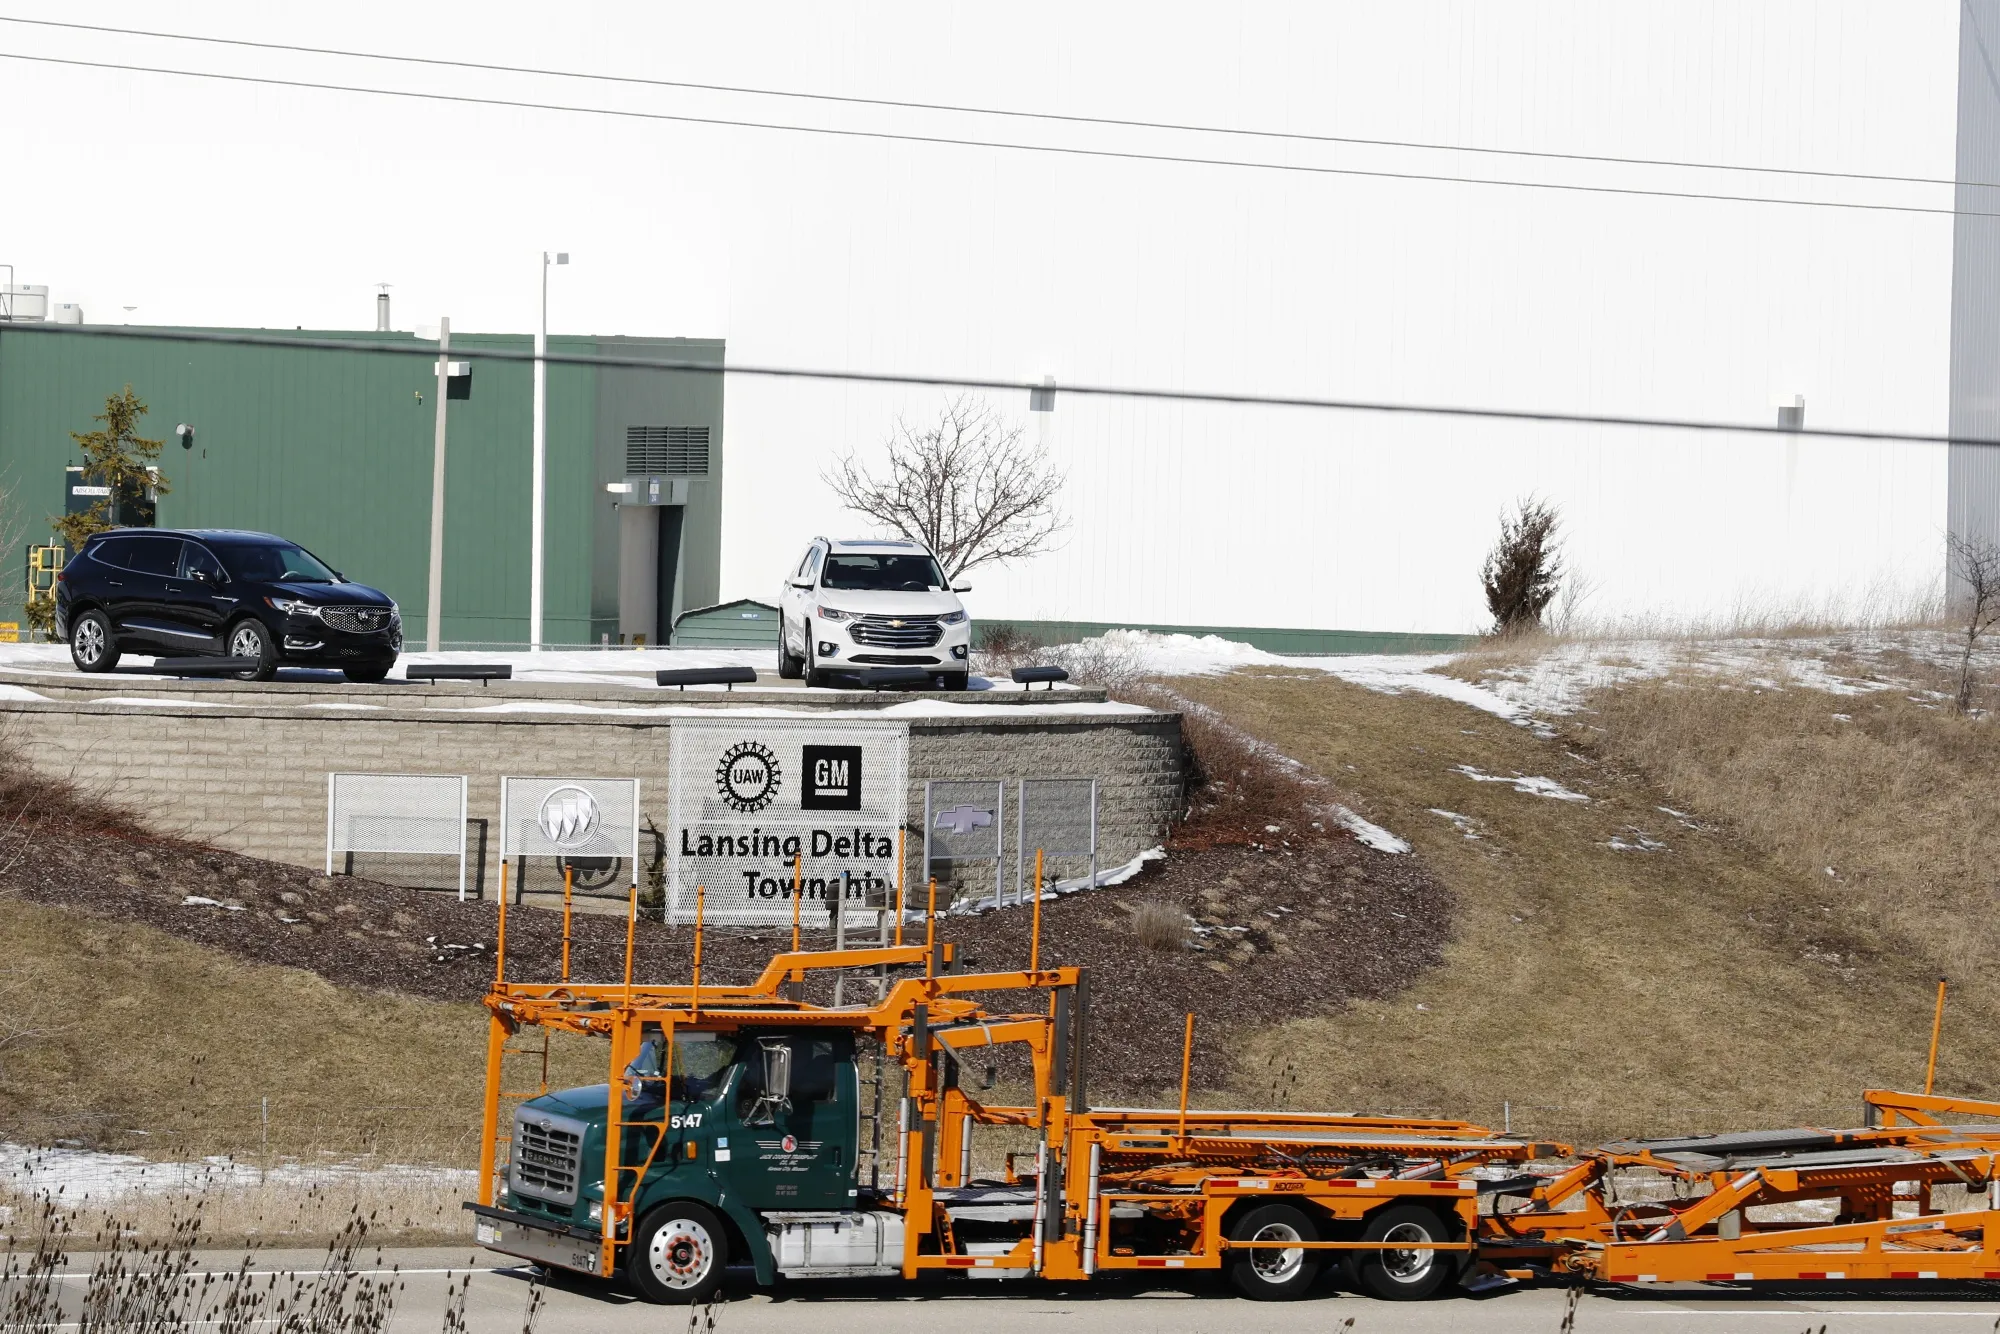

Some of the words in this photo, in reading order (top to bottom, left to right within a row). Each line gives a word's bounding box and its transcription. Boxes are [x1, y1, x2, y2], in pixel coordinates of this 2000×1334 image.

[734, 769, 764, 784] UAW
[814, 759, 849, 787] GM
[681, 828, 801, 866] Lansing
[811, 828, 893, 858] Delta
[671, 1113, 703, 1129] 5147
[571, 1253, 587, 1268] 5147
